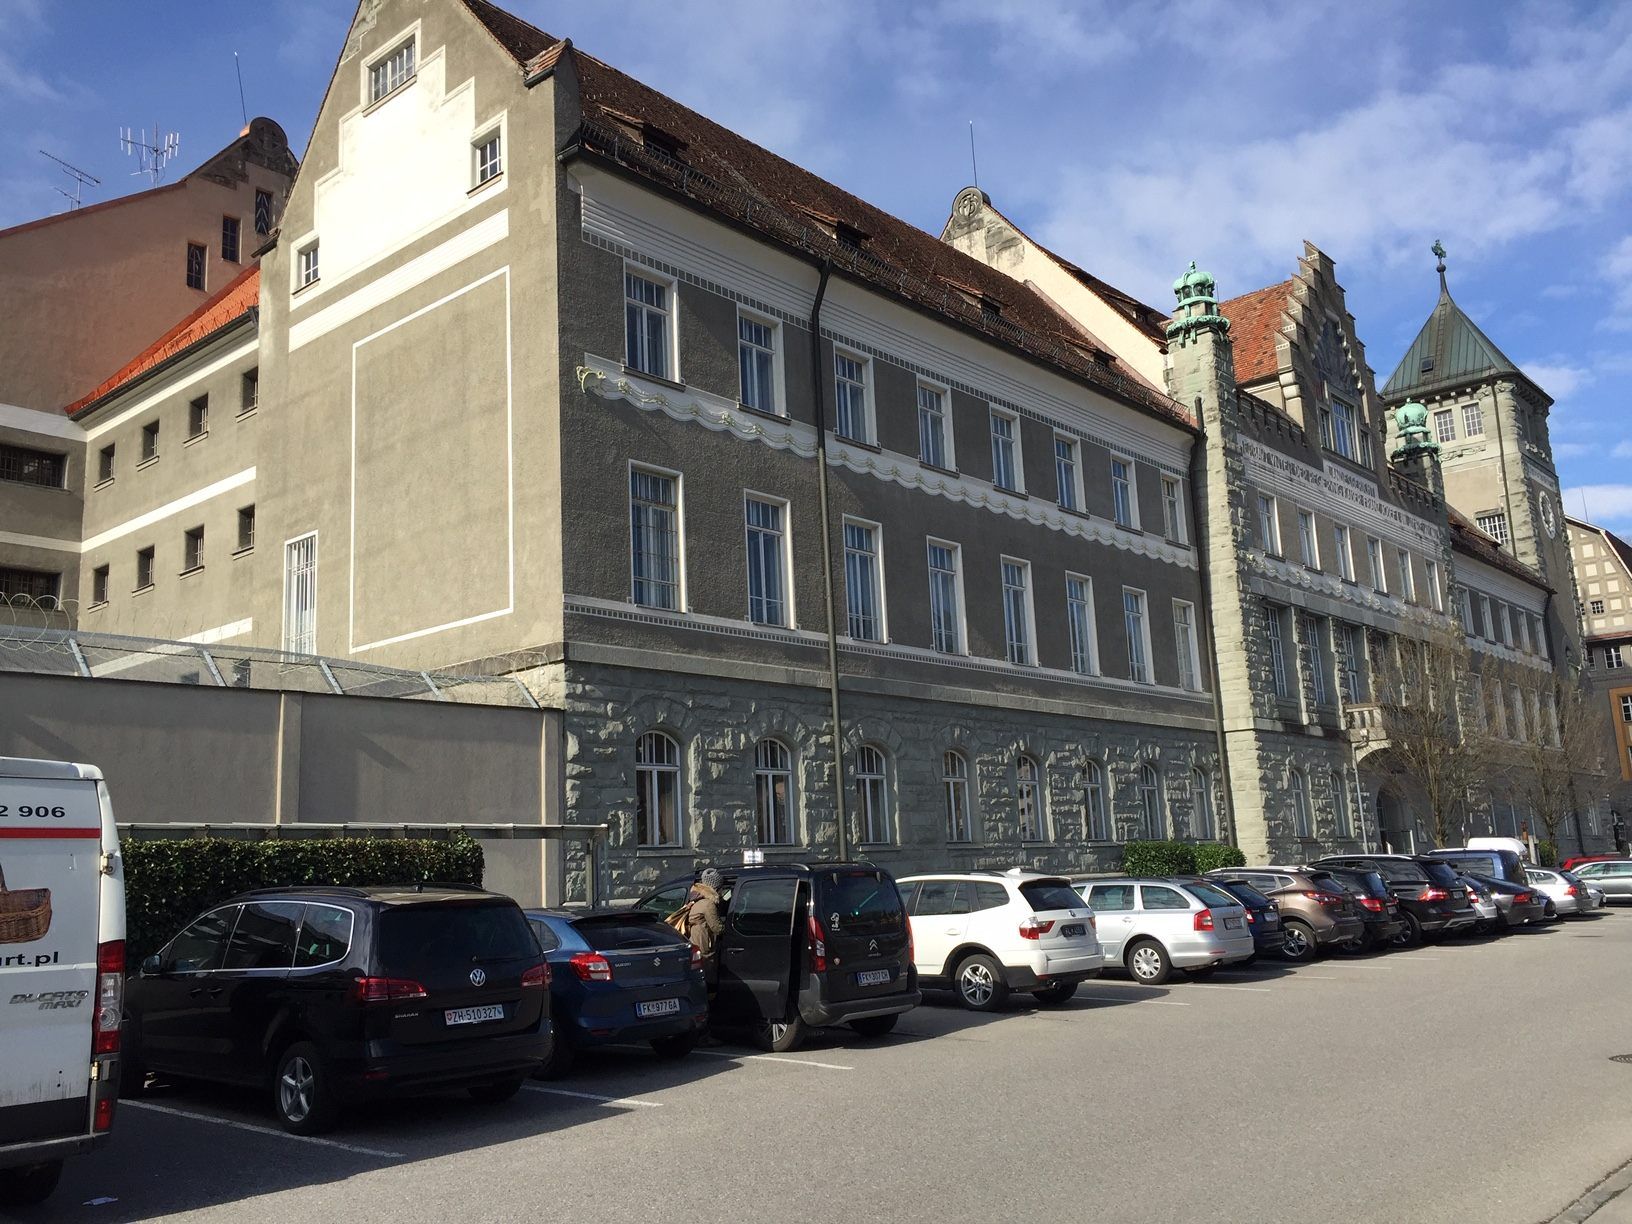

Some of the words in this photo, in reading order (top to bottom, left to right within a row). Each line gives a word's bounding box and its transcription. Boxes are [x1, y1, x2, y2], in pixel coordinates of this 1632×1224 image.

[18, 805, 66, 818] 906
[0, 951, 59, 967] rt.pl
[8, 990, 89, 1004] DUCATO
